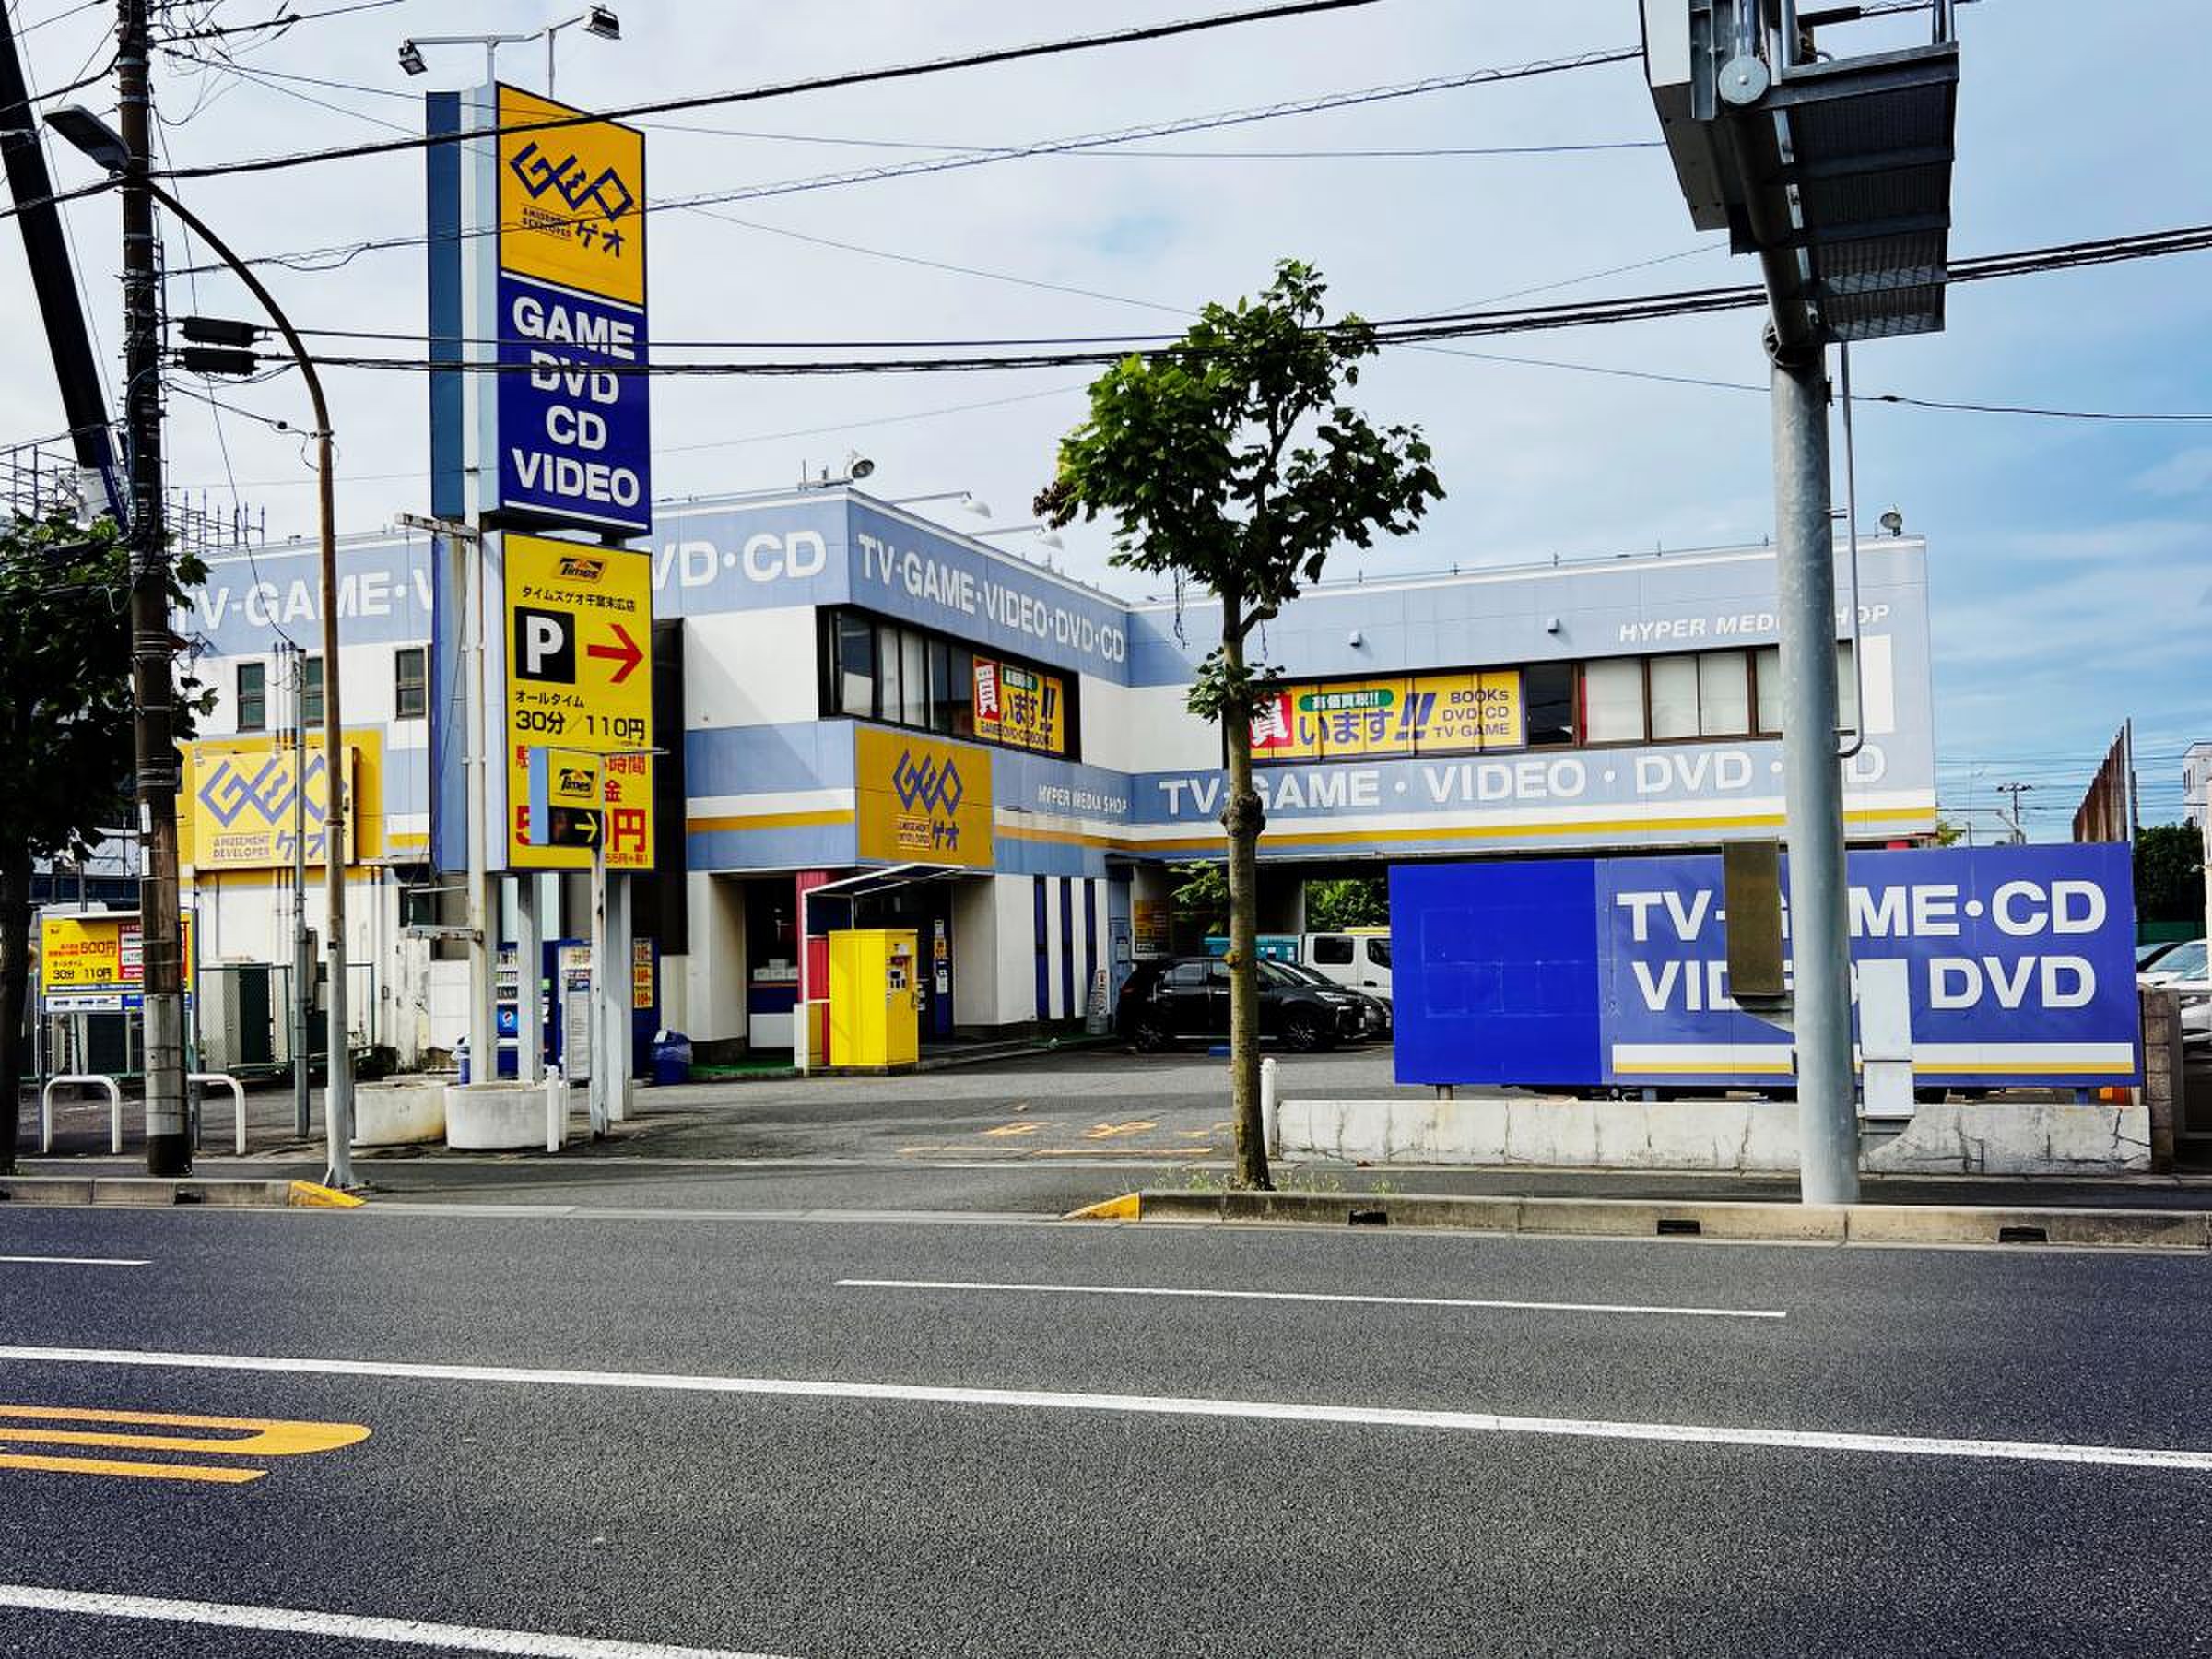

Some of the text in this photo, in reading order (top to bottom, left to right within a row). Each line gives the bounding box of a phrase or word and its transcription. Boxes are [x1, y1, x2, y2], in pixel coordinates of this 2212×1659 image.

[512, 295, 635, 360] GAME
[531, 349, 620, 405] DVD
[546, 404, 606, 451] CD
[512, 447, 641, 508] VIDEO
[743, 530, 828, 582] CD
[526, 615, 564, 674] P
[1618, 618, 1706, 642] HYPER
[1715, 613, 1781, 635] MEDI
[516, 690, 585, 708] オールタイム
[1424, 759, 1586, 803] VIDEO
[1635, 750, 1753, 794] DVD
[1992, 880, 2107, 936] CD
[1929, 955, 2096, 1009] DVD
